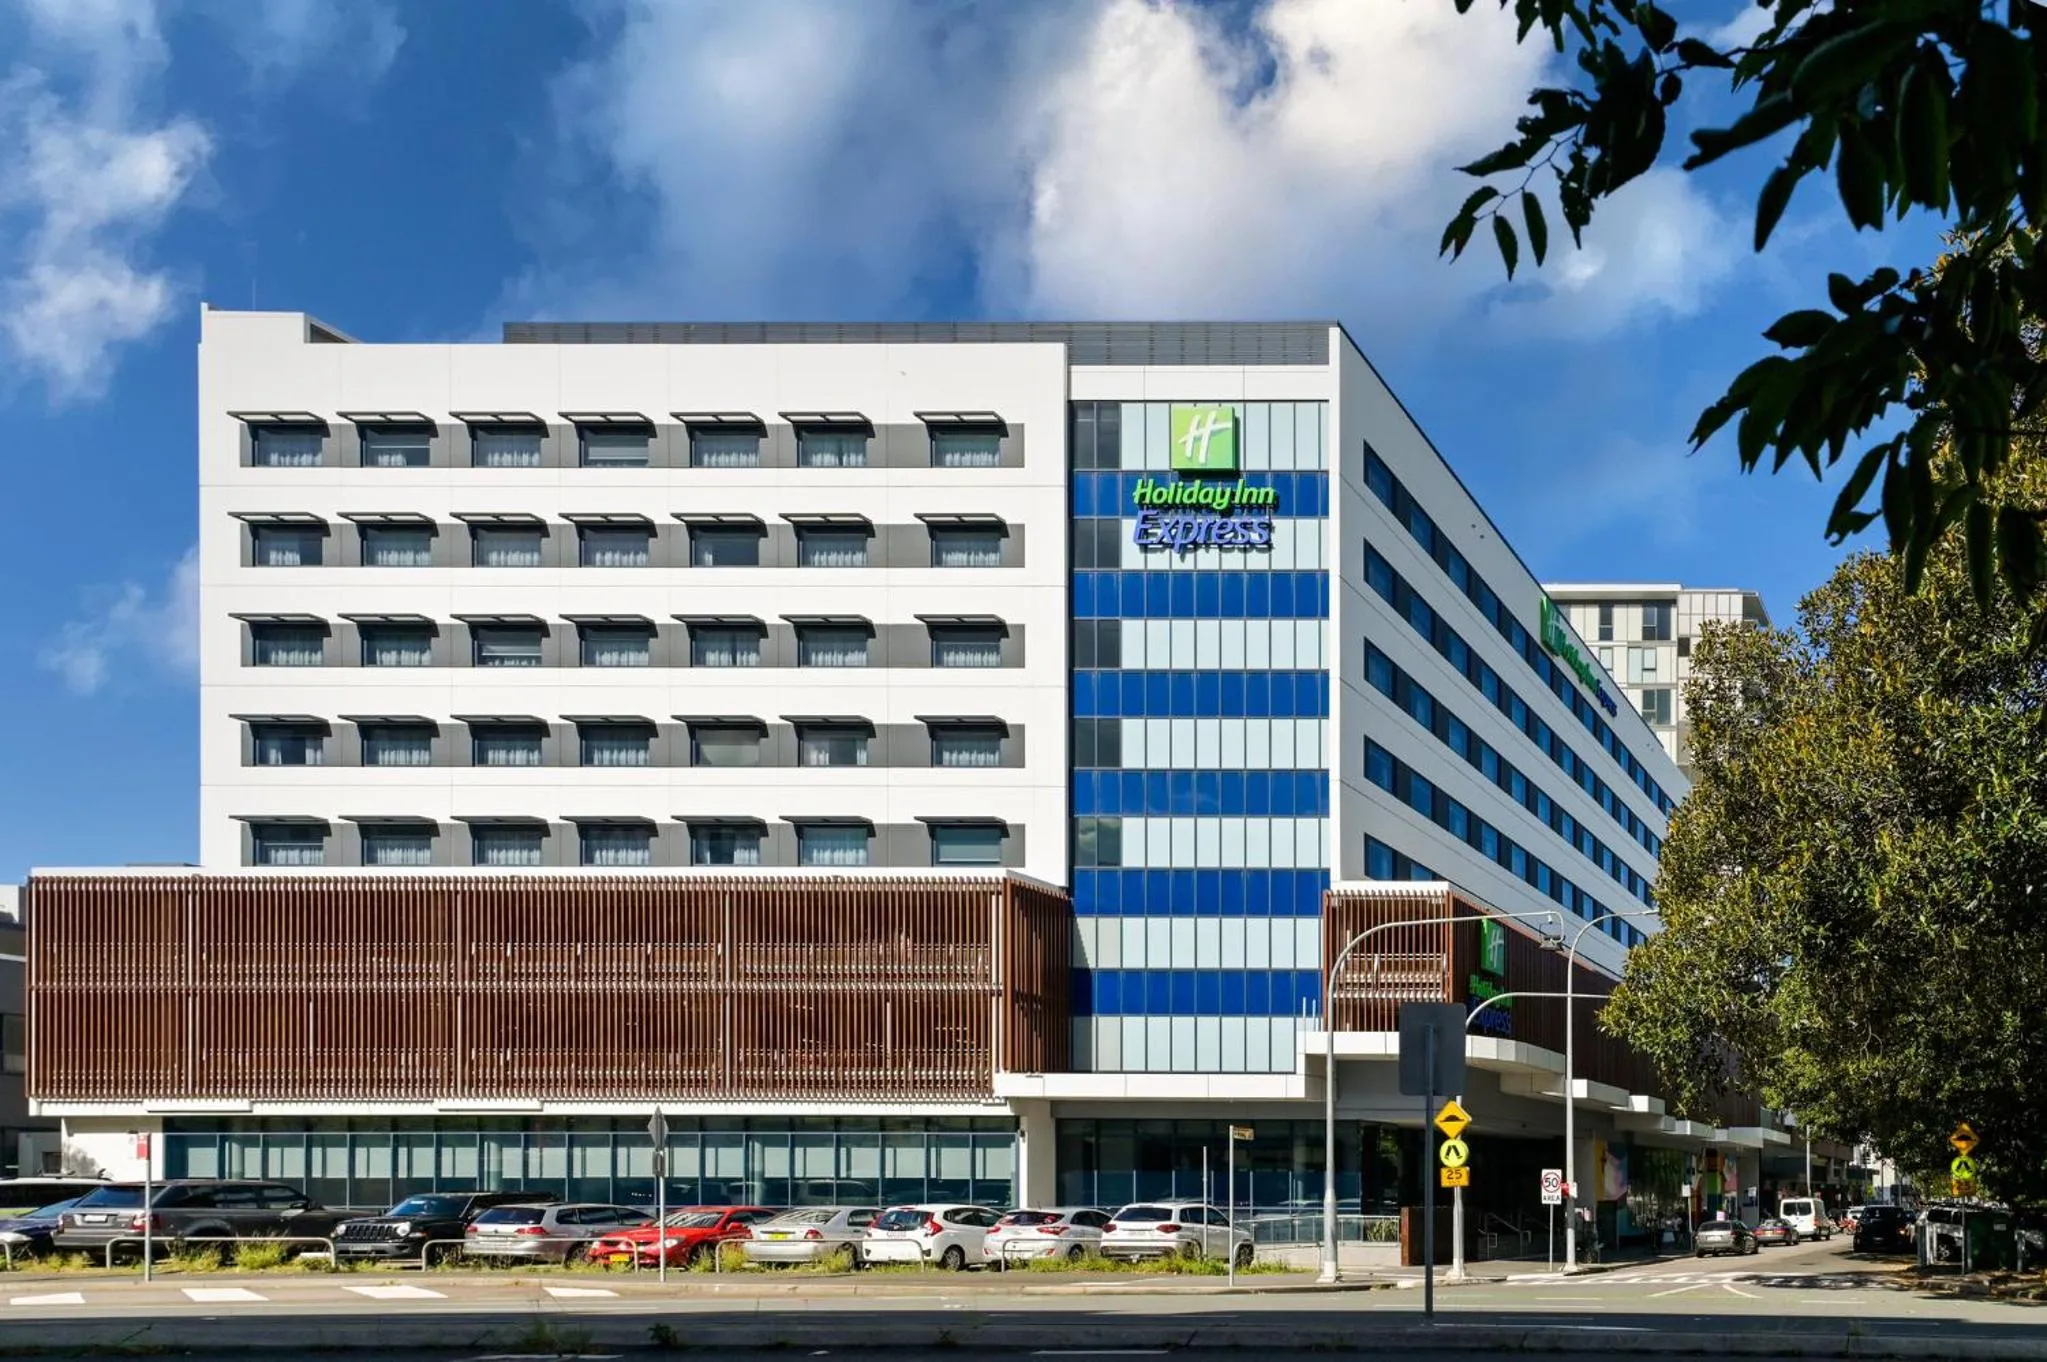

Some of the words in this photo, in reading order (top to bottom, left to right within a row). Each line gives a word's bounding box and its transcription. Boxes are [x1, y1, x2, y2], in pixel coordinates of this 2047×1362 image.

[1178, 410, 1232, 464] H
[1133, 478, 1231, 510] Holiday
[1235, 478, 1276, 505] Inn
[1133, 509, 1271, 554] Express
[1447, 1169, 1462, 1180] 25
[1545, 1177, 1558, 1188] 50
[1542, 1194, 1561, 1202] AREA
